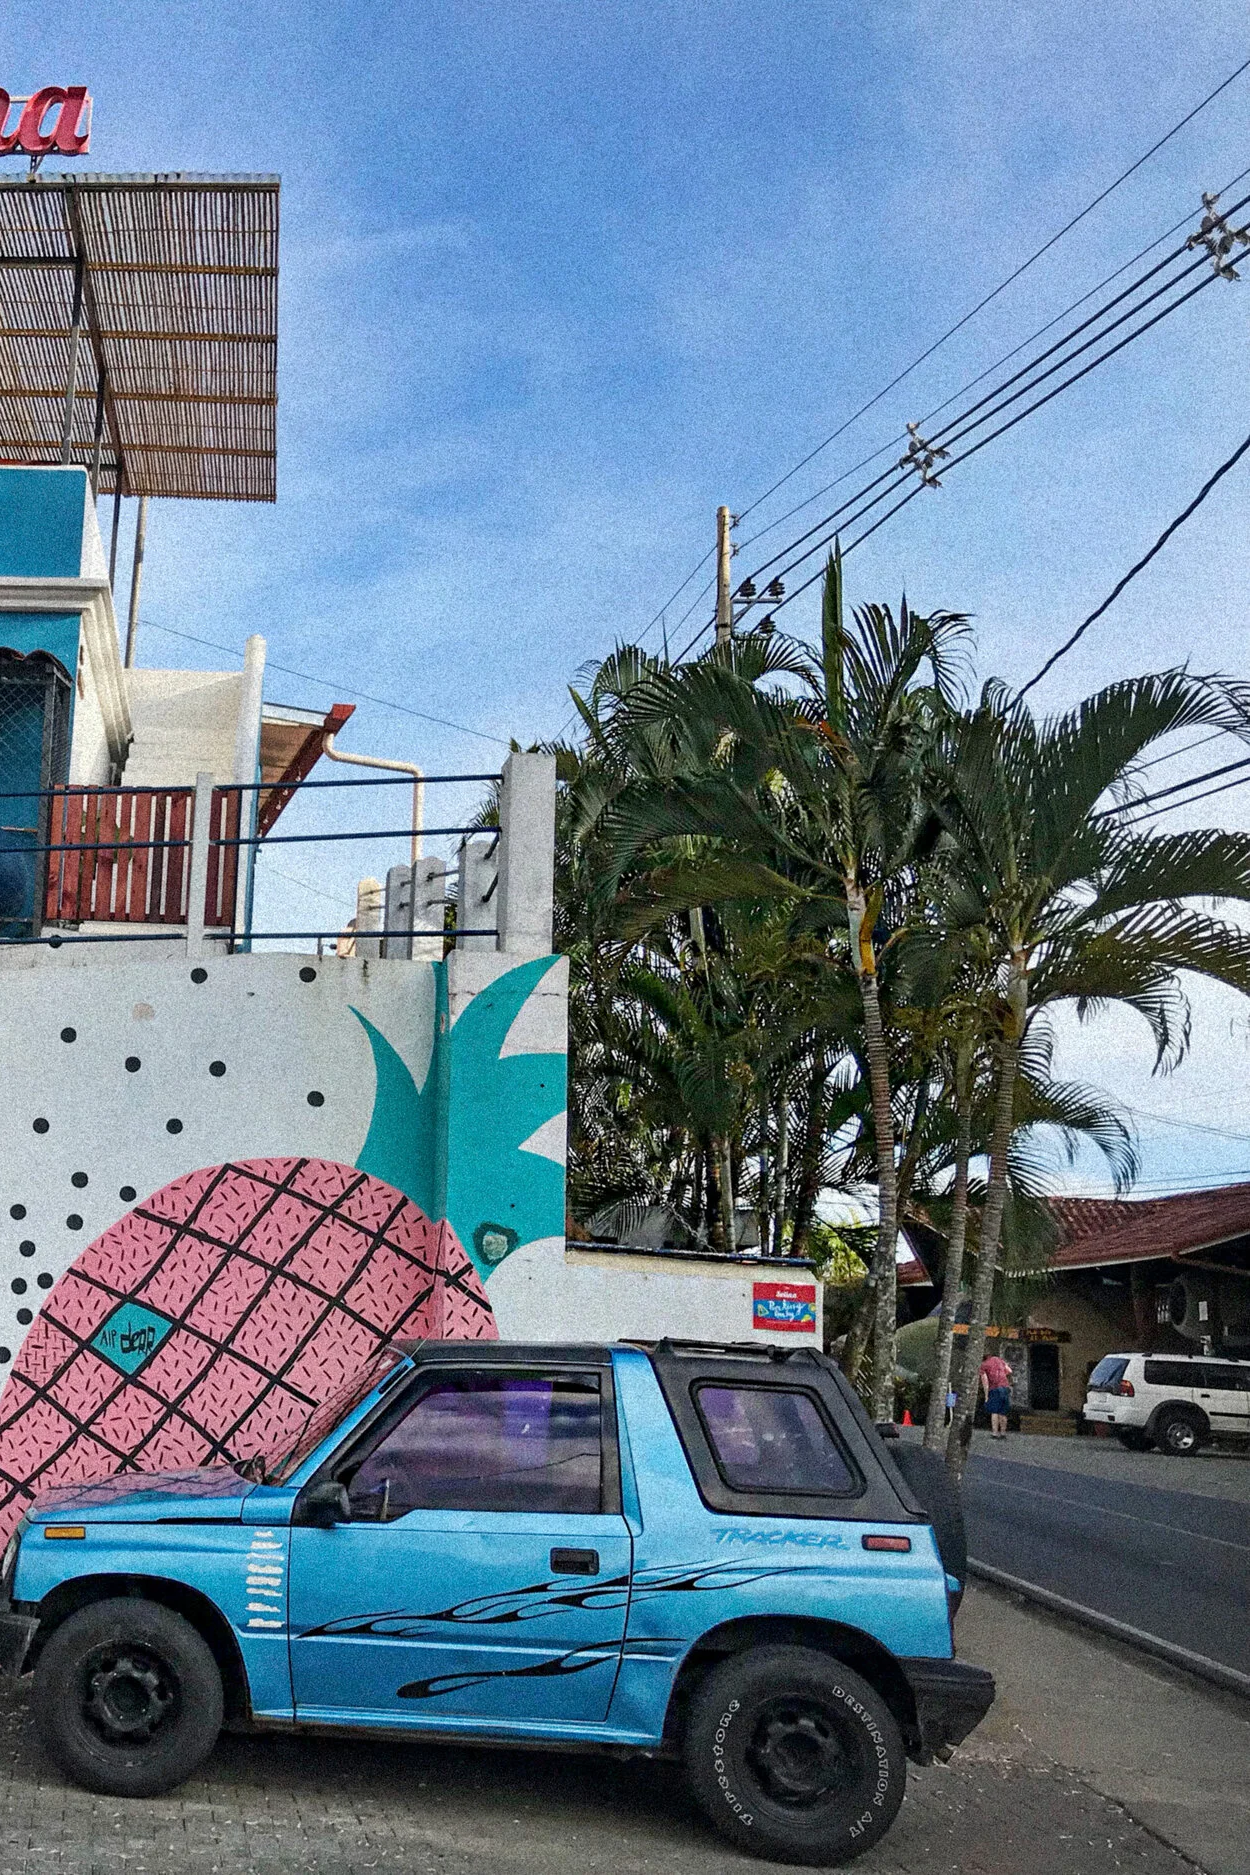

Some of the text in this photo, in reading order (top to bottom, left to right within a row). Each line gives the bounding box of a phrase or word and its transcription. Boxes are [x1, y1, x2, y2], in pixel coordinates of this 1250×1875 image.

[767, 1299, 807, 1316] Parking
[710, 1527, 851, 1551] TRACKER
[832, 1685, 889, 1838] DESTINATION A/T
